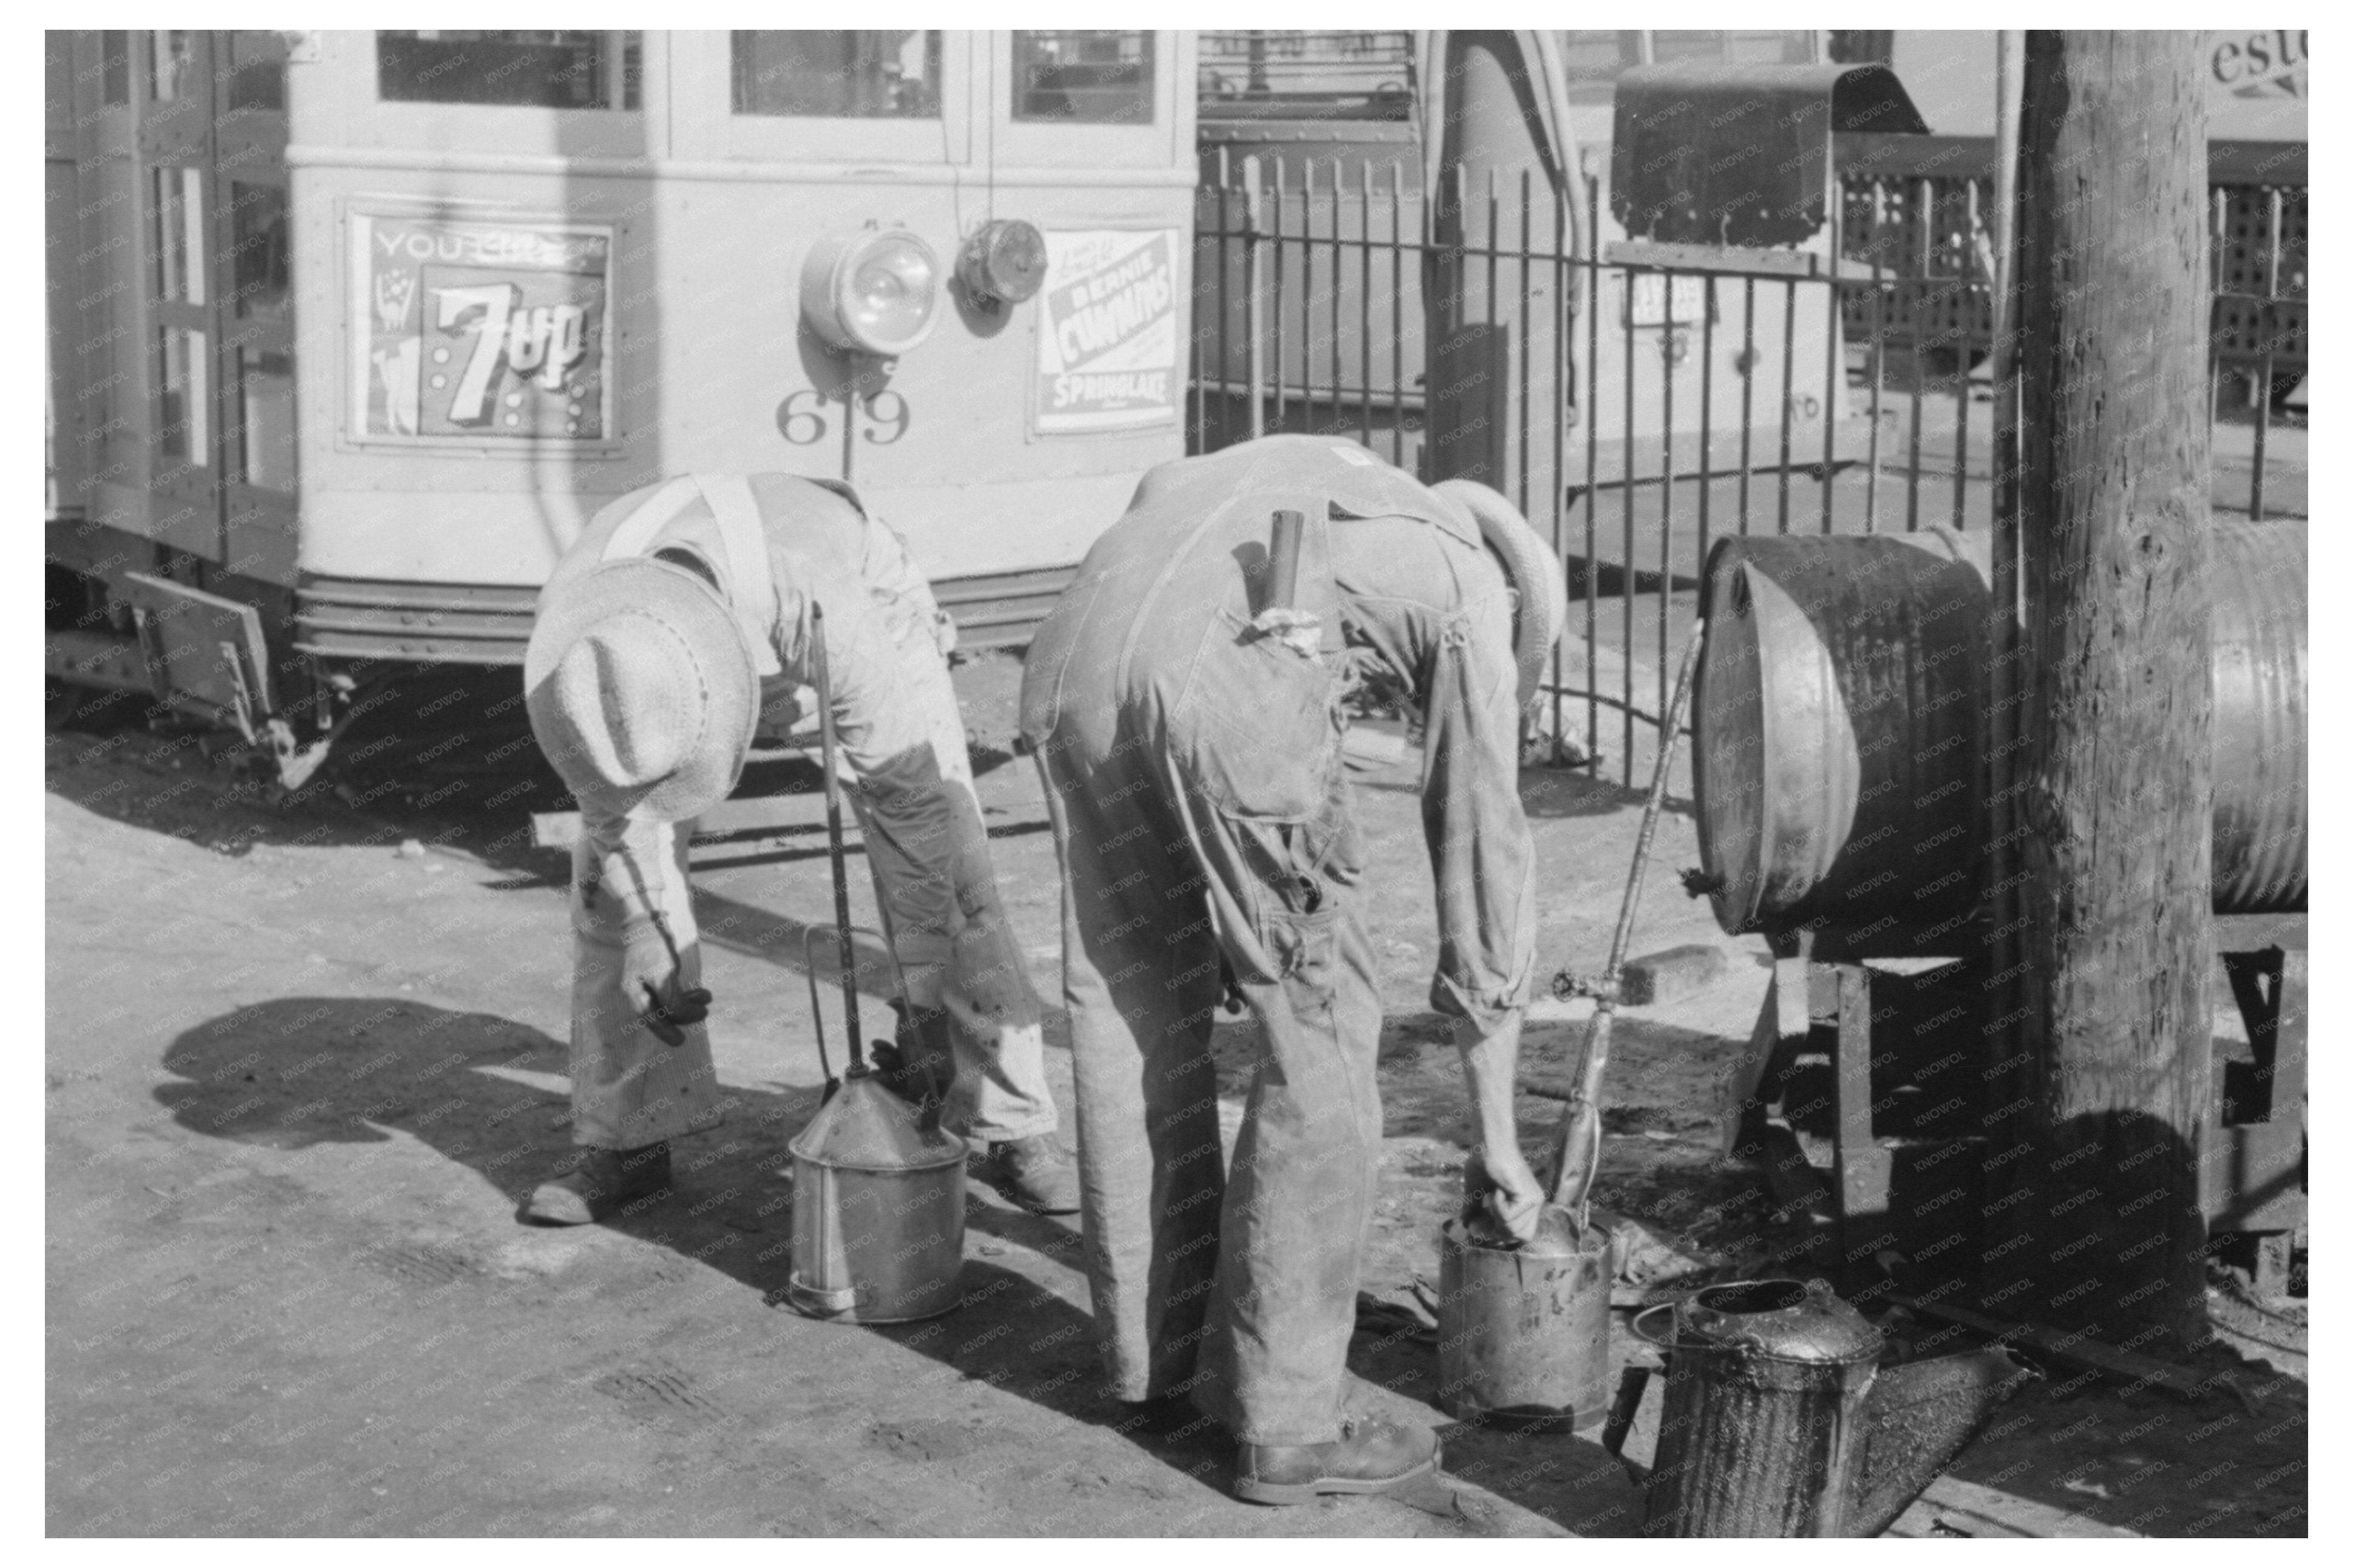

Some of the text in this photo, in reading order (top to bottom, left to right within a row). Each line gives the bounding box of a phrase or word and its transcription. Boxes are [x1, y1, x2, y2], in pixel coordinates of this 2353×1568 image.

[2211, 29, 2308, 83] est
[375, 231, 463, 259] YOU
[1071, 249, 1153, 308] BERNIE
[776, 390, 910, 445] 69
